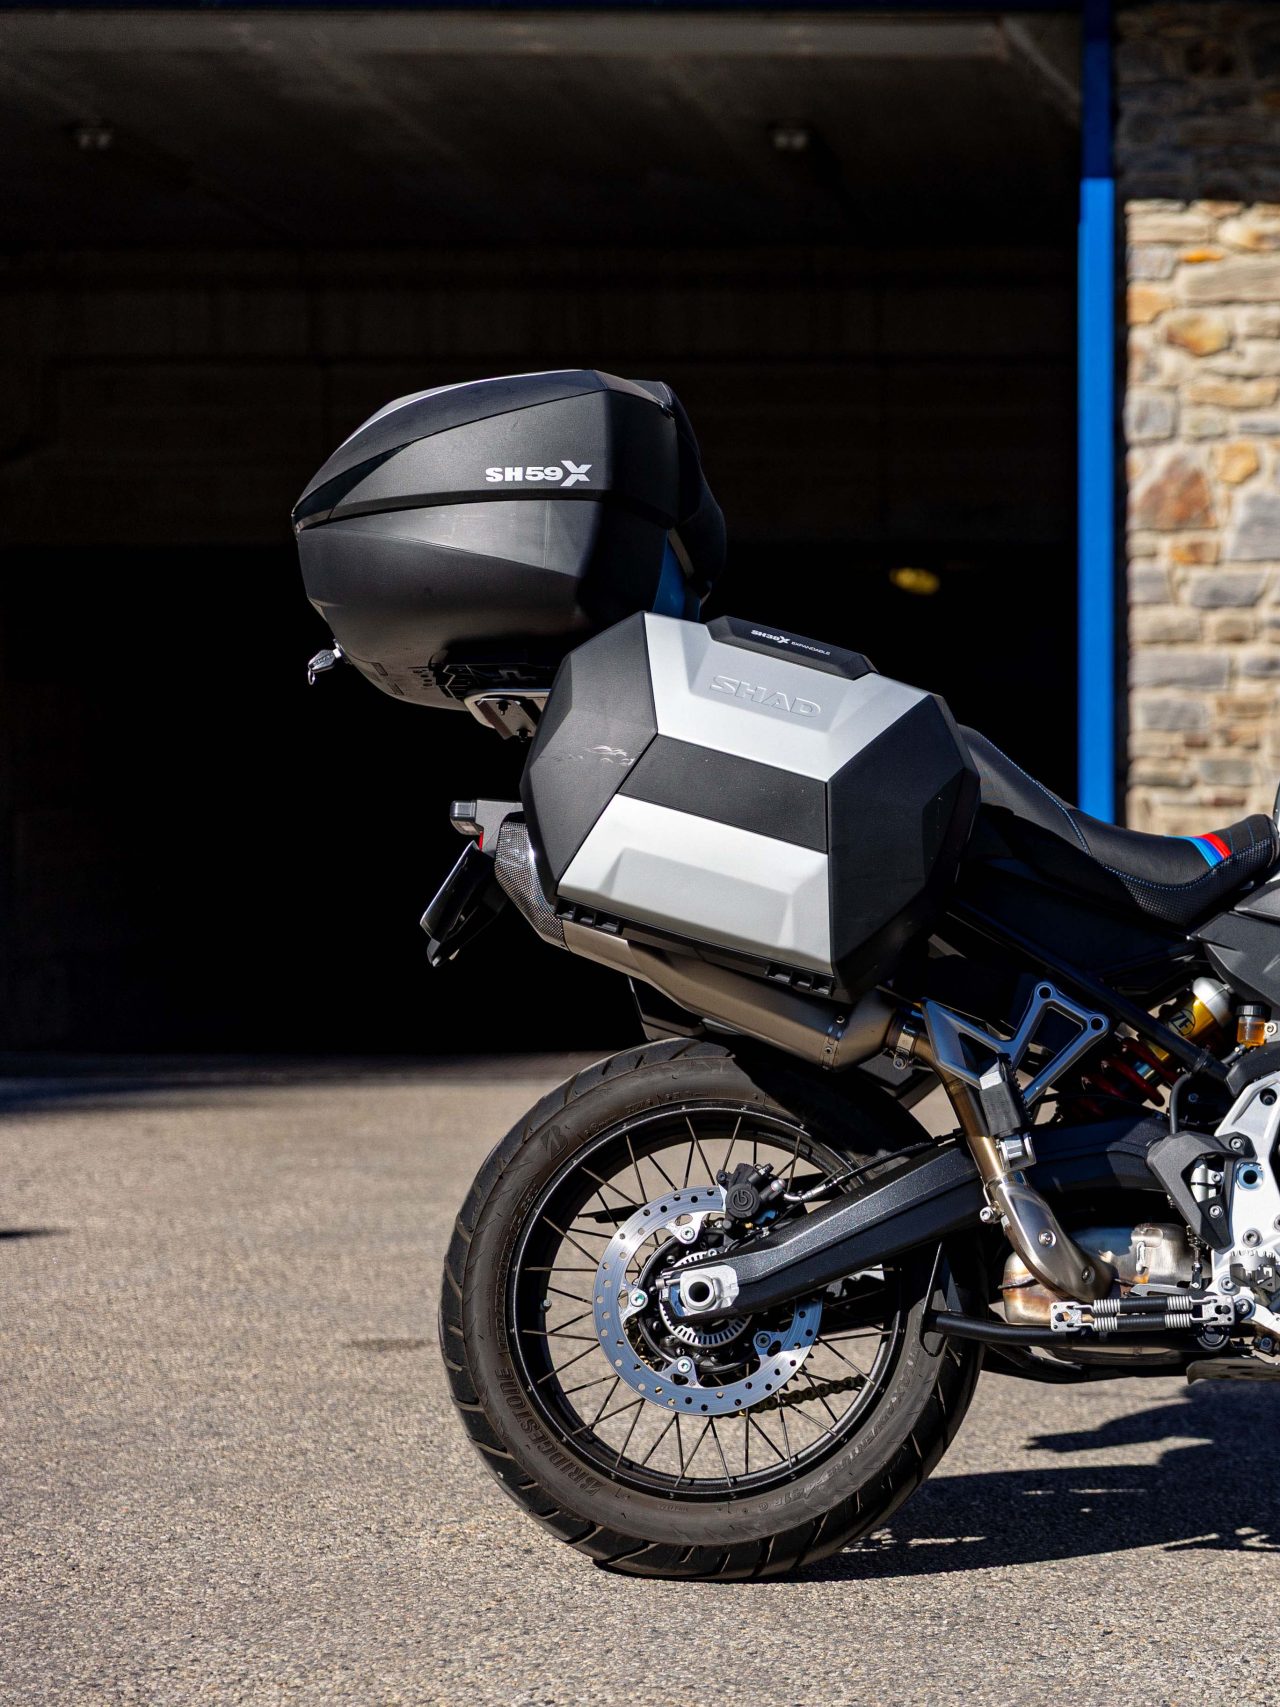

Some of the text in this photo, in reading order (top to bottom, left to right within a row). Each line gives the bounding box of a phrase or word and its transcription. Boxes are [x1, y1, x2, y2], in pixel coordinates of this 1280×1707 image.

[485, 460, 592, 487] SH59X
[791, 641, 831, 656] EXPANDABLE
[710, 674, 821, 717] SHAD
[495, 1367, 602, 1497] BRIDGESTONE
